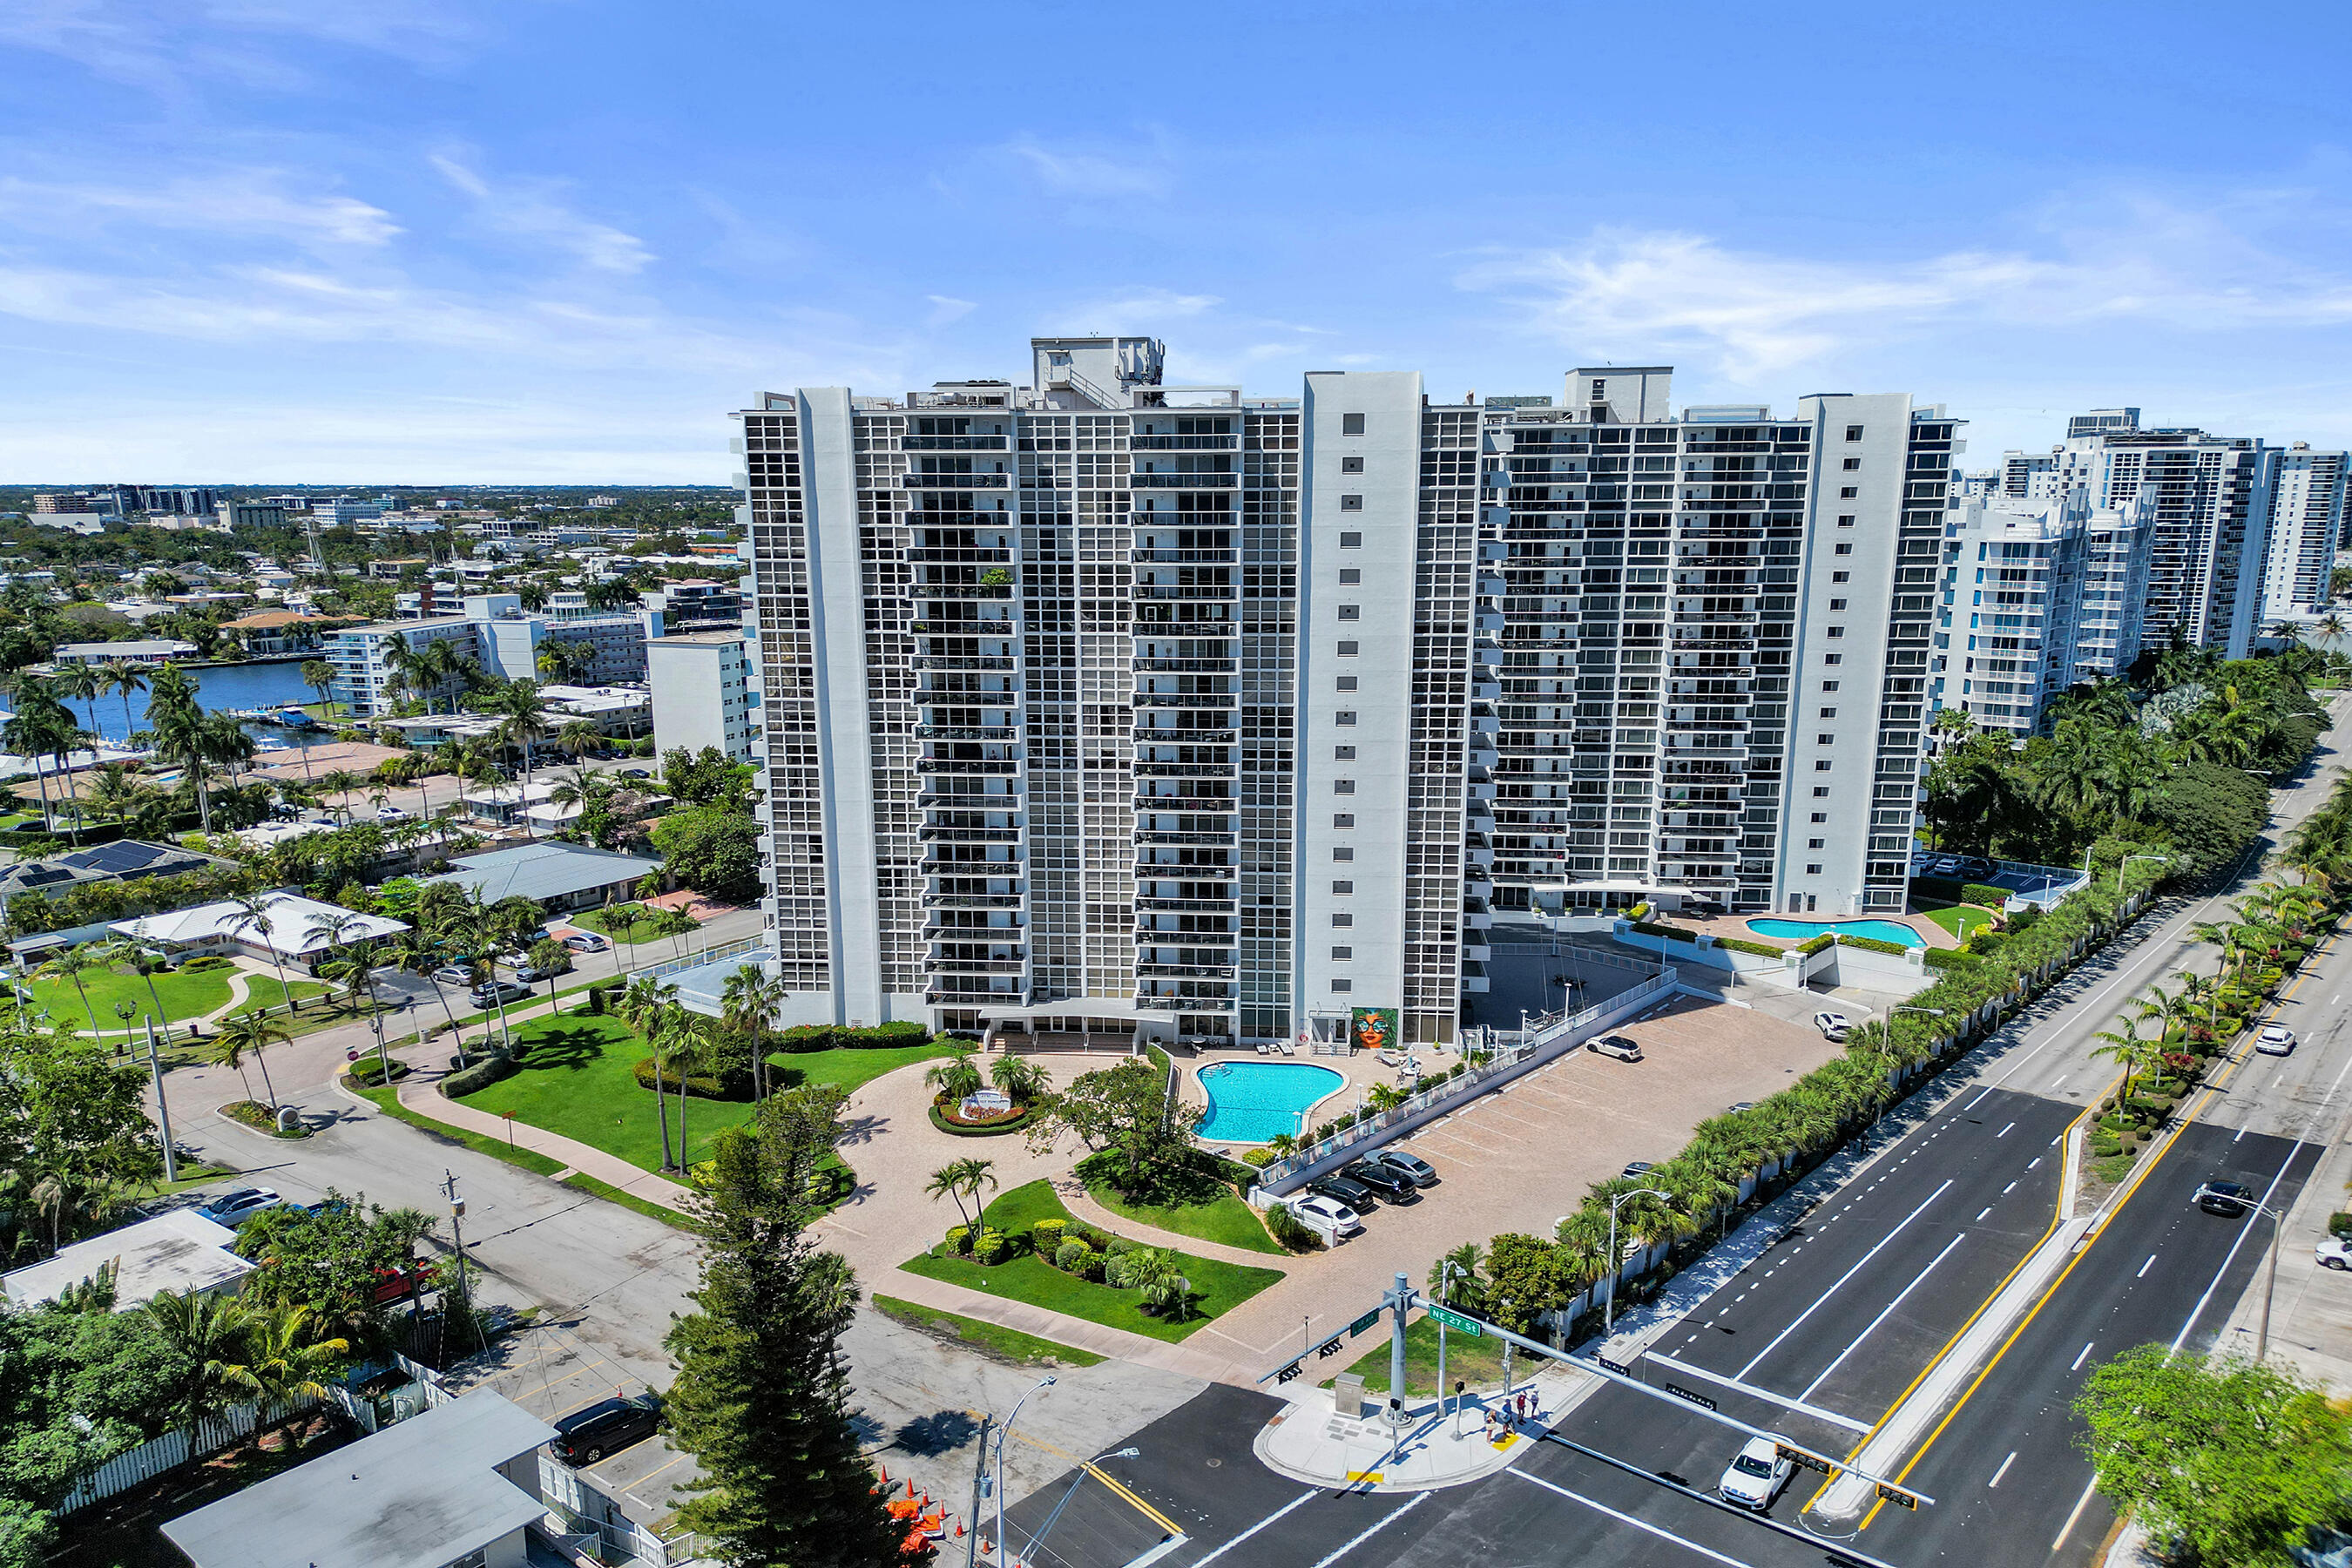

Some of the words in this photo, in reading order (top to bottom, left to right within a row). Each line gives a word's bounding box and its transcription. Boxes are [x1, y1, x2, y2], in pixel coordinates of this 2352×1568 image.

[1432, 1309, 1446, 1321] NE
[1449, 1315, 1462, 1326] 27
[1465, 1322, 1477, 1333] St
